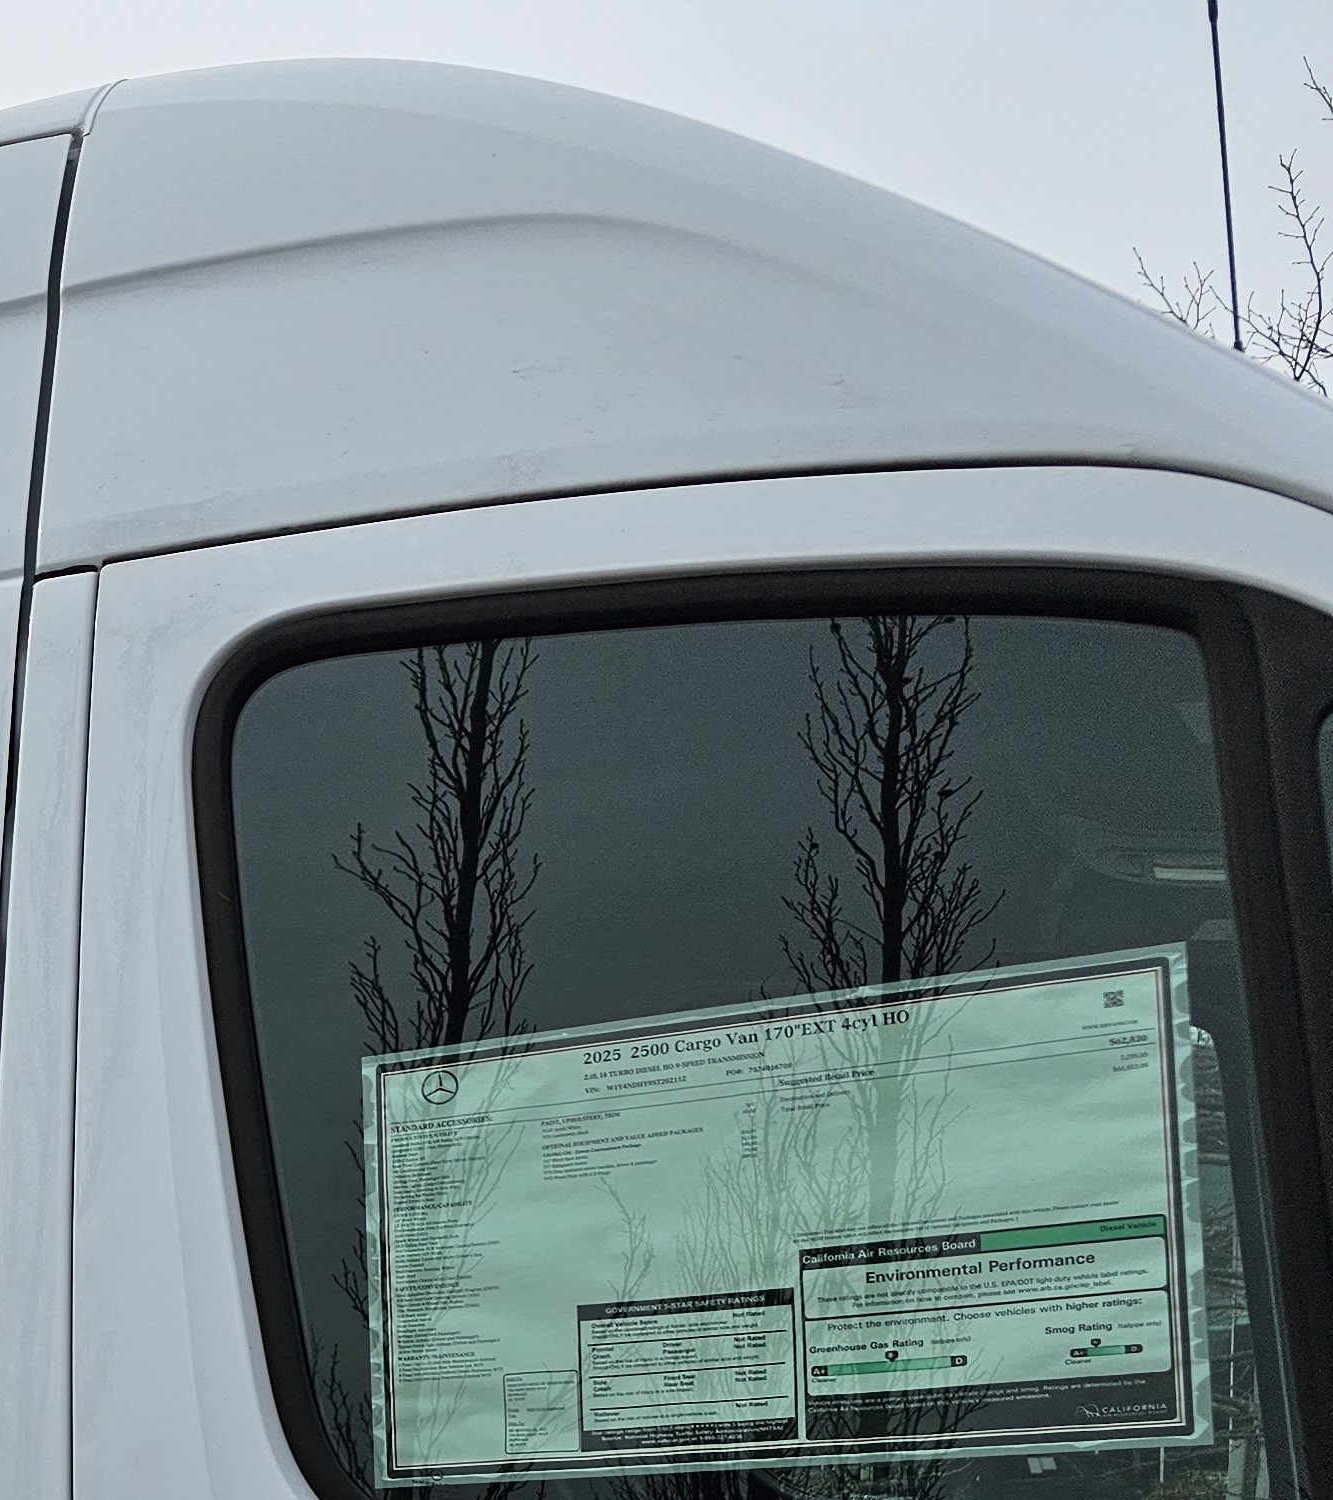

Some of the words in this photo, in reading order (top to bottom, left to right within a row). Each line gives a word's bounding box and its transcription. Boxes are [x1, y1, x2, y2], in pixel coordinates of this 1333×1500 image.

[584, 1049, 621, 1064] 2025
[631, 1042, 669, 1058] 2500
[675, 1036, 721, 1052] Cargo
[726, 1032, 759, 1046] Van
[765, 1020, 836, 1041] 170"EXT
[841, 1014, 877, 1032] 4cyl
[883, 1010, 909, 1026] HO
[609, 1068, 634, 1078] TURBO
[635, 1066, 661, 1074] DIESEL
[675, 1059, 705, 1070] 9-SPEED
[707, 1052, 765, 1064] TRANSMISSION
[779, 1075, 822, 1086] Suggested
[825, 1072, 849, 1080] Retail
[851, 1070, 875, 1078] Price
[391, 1122, 433, 1134] STANDARD
[573, 1138, 609, 1146] EQUIPMENT
[647, 1130, 668, 1139] ADDED
[669, 1127, 703, 1136] PACKAGES
[1100, 1224, 1125, 1232] Diesel
[1128, 1221, 1157, 1230] Vehicle
[803, 1252, 854, 1264] California
[857, 1248, 874, 1258] Air
[878, 1243, 938, 1257] Resources
[942, 1239, 975, 1250] Board
[866, 1262, 982, 1284] Environmental
[989, 1254, 1095, 1272] Performance
[839, 1294, 862, 1302] ratings
[891, 1290, 915, 1298] directly
[917, 1286, 958, 1295] comparable
[1001, 1278, 1035, 1287] EPA/DOT
[1036, 1276, 1071, 1284] light-duty
[1073, 1272, 1099, 1280] vehicle
[1101, 1270, 1118, 1278] label
[1121, 1268, 1149, 1276] ratings.
[605, 1304, 661, 1314] GOVERNMENT
[664, 1301, 693, 1310] 5-STAR
[695, 1298, 726, 1306] SAFETY
[728, 1295, 765, 1304] RATINGS
[865, 1300, 904, 1308] information
[978, 1290, 1001, 1298] please
[827, 1322, 862, 1332] Protect
[866, 1320, 882, 1328] the
[885, 1314, 949, 1327] environment.
[953, 1311, 991, 1321] Choose
[995, 1306, 1036, 1318] vehicles
[1039, 1303, 1063, 1313] with
[1066, 1300, 1098, 1312] higher
[1103, 1298, 1143, 1309] ratings:
[1045, 1324, 1074, 1335] Smog
[1079, 1322, 1113, 1332] Rating
[809, 1342, 867, 1354] Greenhouse
[870, 1340, 889, 1350] Gas
[893, 1338, 923, 1348] Rating
[813, 1368, 825, 1376] A+
[1101, 1402, 1167, 1413] CALIFORNIA
